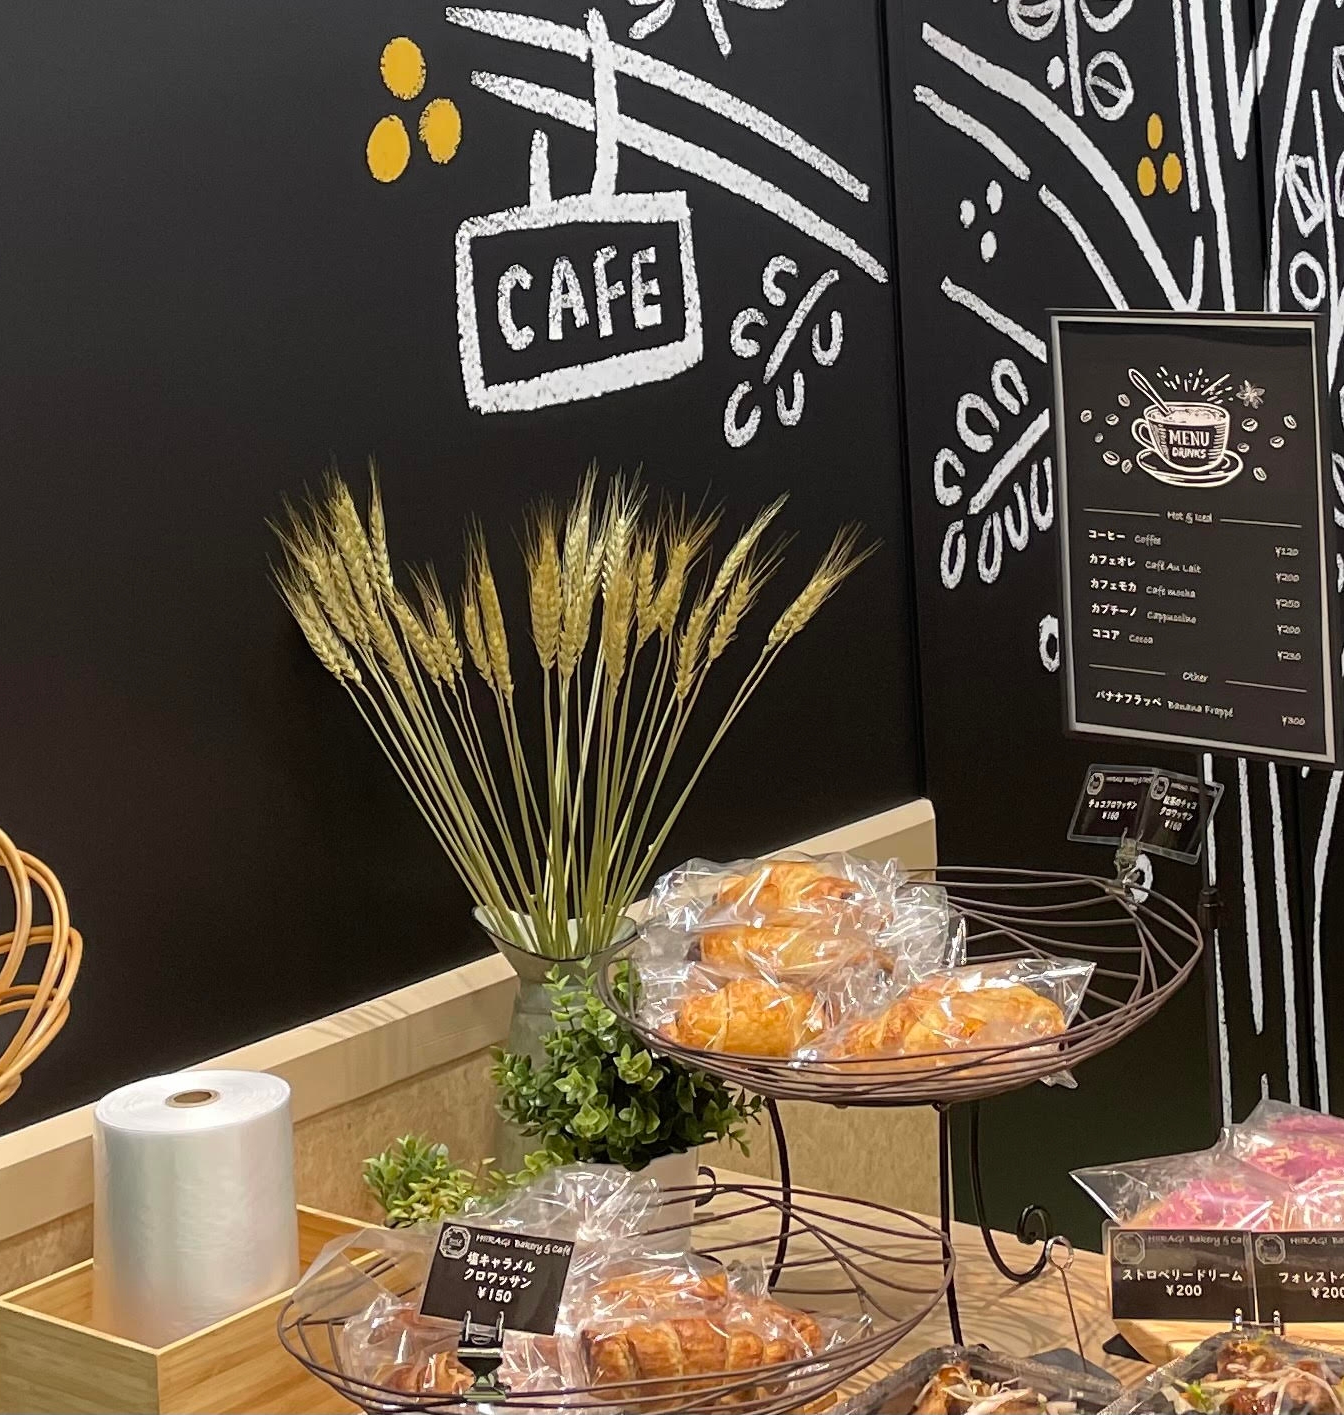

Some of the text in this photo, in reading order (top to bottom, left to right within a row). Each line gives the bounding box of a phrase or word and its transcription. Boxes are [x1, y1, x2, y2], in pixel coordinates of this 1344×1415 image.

[497, 244, 662, 351] CAFE
[1168, 429, 1210, 447] MENU
[1171, 446, 1207, 459] DRINKS
[1167, 510, 1184, 521] Hot
[1088, 529, 1126, 541] コーヒー
[1134, 534, 1162, 546] Coffee
[1089, 553, 1136, 567] カフェオレ
[1090, 578, 1137, 592] カフェモカ
[1091, 602, 1137, 617] カプチーノ
[1092, 628, 1120, 641] ココア
[1182, 671, 1208, 683] Other
[514, 1239, 542, 1256] Bakery
[466, 1251, 536, 1274] 塩キャラメル
[463, 1268, 532, 1289] クロワッサン
[1122, 1269, 1244, 1283] ストロベリードリーム
[477, 1286, 513, 1303] ¥150
[1165, 1285, 1203, 1297] ¥200
